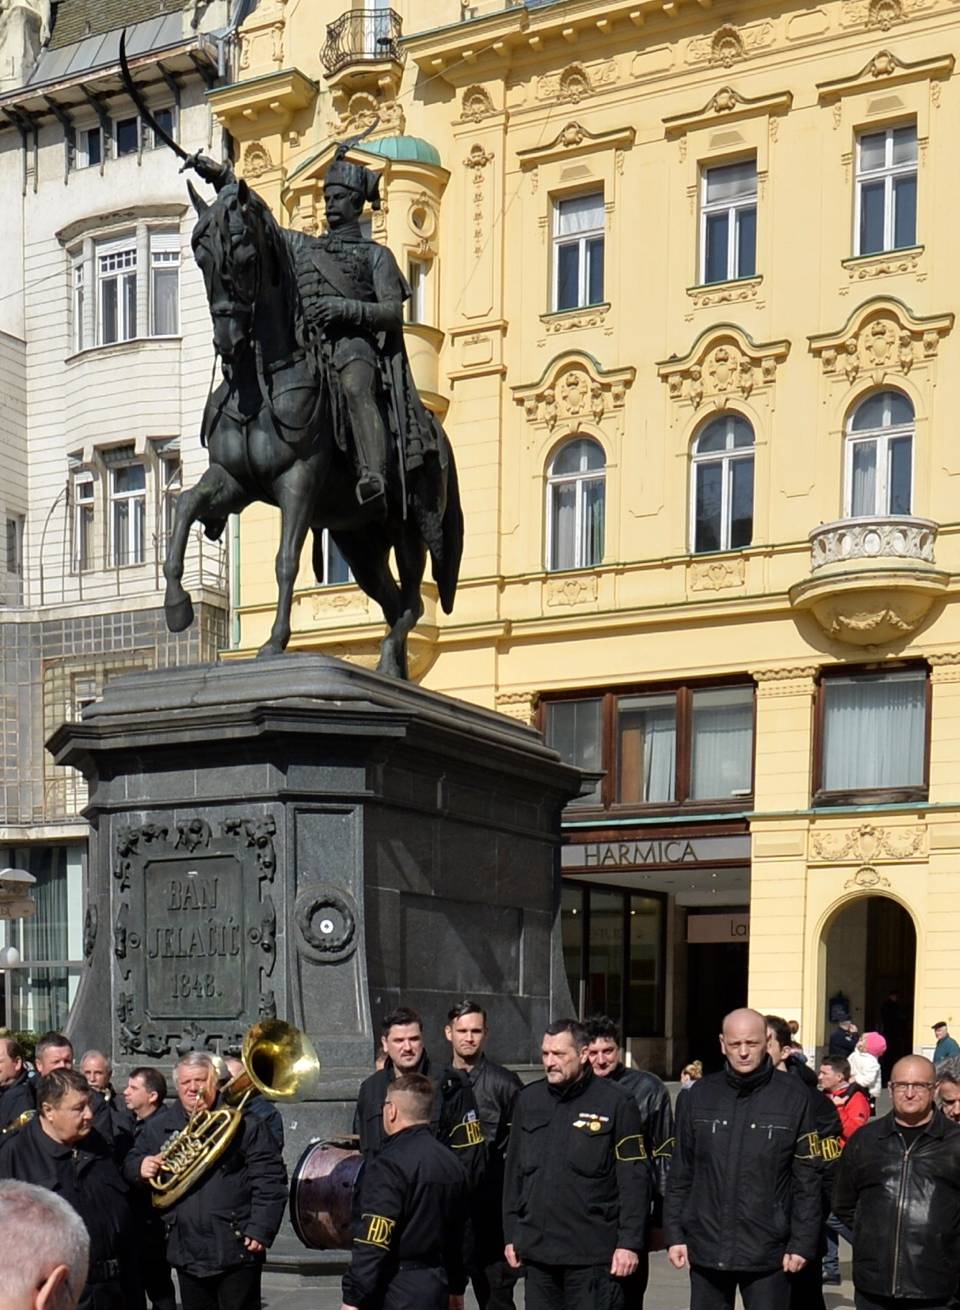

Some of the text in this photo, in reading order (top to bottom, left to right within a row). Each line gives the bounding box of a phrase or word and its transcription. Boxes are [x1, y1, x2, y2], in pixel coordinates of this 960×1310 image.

[583, 840, 698, 868] HARMICA
[167, 878, 219, 911] BAN
[730, 919, 750, 937] La
